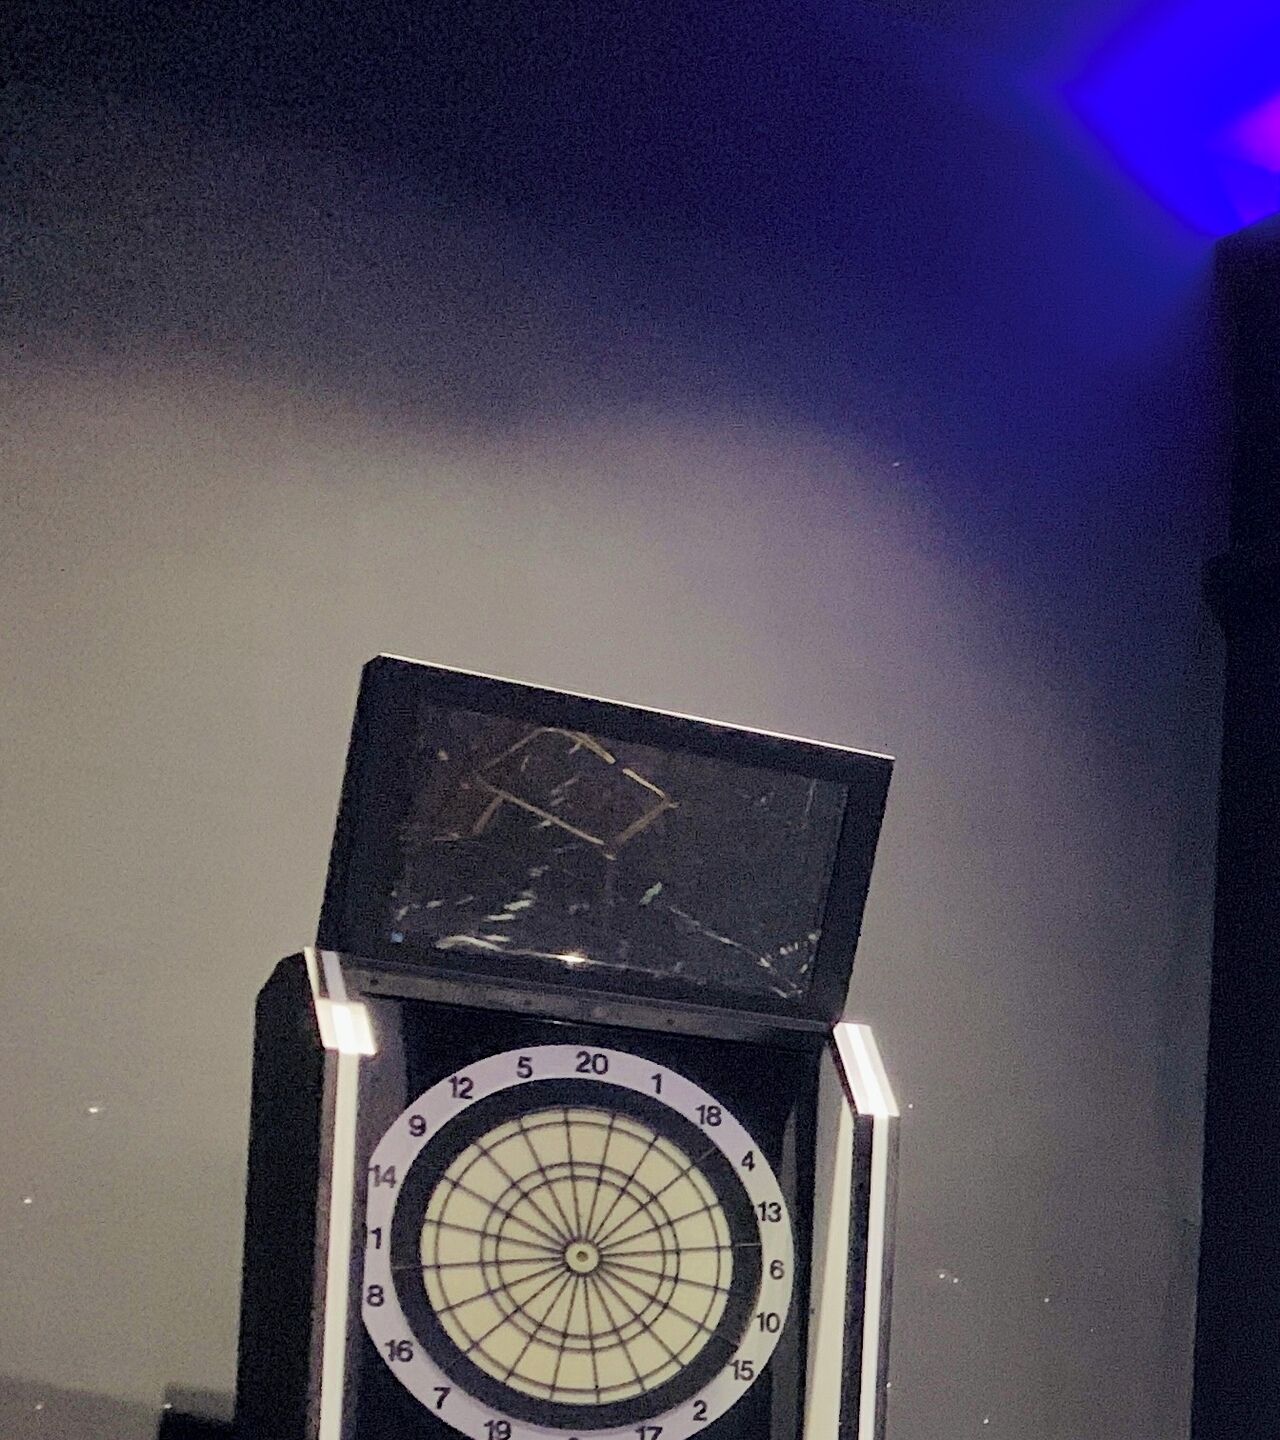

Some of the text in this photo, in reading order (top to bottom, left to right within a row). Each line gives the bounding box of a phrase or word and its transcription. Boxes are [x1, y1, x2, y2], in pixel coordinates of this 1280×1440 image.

[517, 1056, 533, 1079] 5
[575, 1051, 609, 1075] 20
[448, 1076, 474, 1100] 12
[651, 1073, 662, 1095] 1
[409, 1114, 427, 1137] 9
[694, 1104, 723, 1126] 18
[741, 1150, 756, 1172] 4
[370, 1164, 397, 1189] 14
[757, 1201, 782, 1222] 13
[769, 1259, 785, 1280] 6
[366, 1284, 385, 1307] 8
[756, 1312, 780, 1334] 10
[384, 1339, 413, 1363] 16
[729, 1357, 755, 1381] 15
[433, 1386, 451, 1410] 7
[692, 1399, 707, 1422] 2
